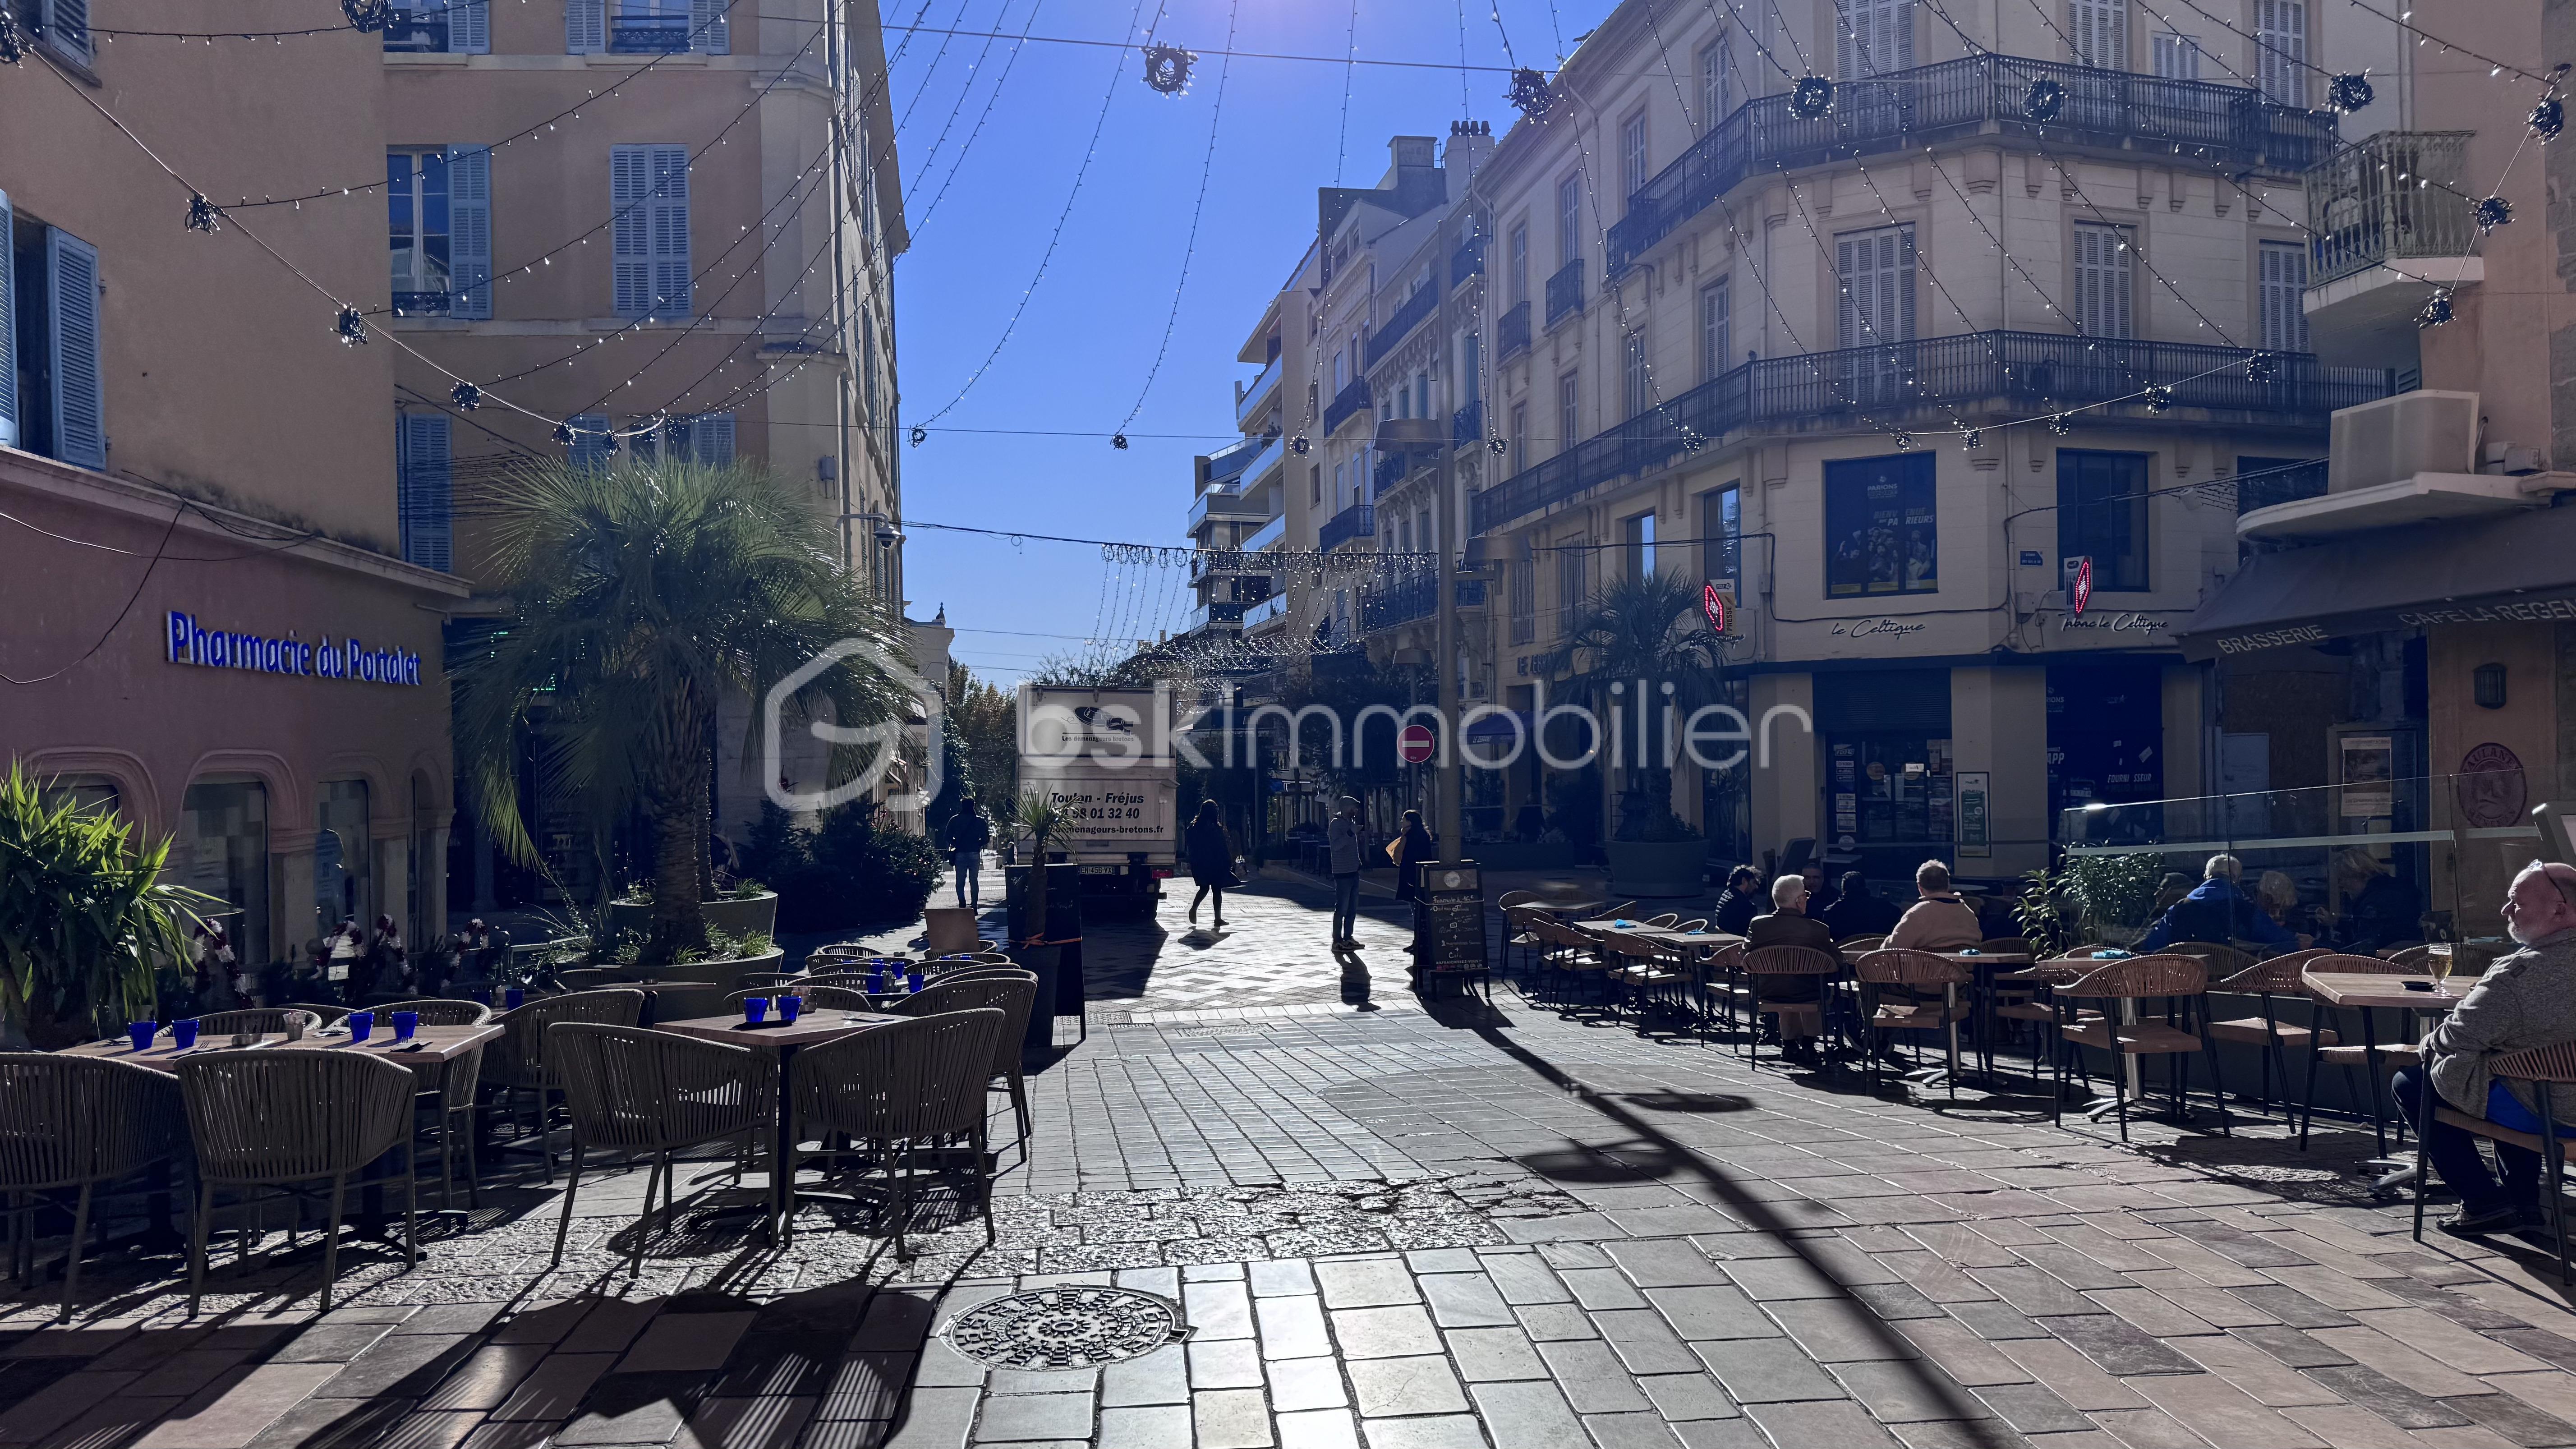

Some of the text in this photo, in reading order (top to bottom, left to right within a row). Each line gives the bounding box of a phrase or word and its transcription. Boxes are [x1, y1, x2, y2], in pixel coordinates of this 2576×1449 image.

[2099, 615, 2111, 628] le
[2113, 613, 2169, 636] Celtique
[2459, 607, 2500, 621] LA
[1832, 619, 1925, 640] le Celtique
[2217, 625, 2329, 654] BRASSERIE
[166, 610, 422, 685] Pharmacie du Portalet
[1105, 791, 1144, 805] Fréjus
[1090, 808, 1104, 819] 01
[1108, 808, 1122, 819] 32
[1125, 808, 1140, 819] 40
